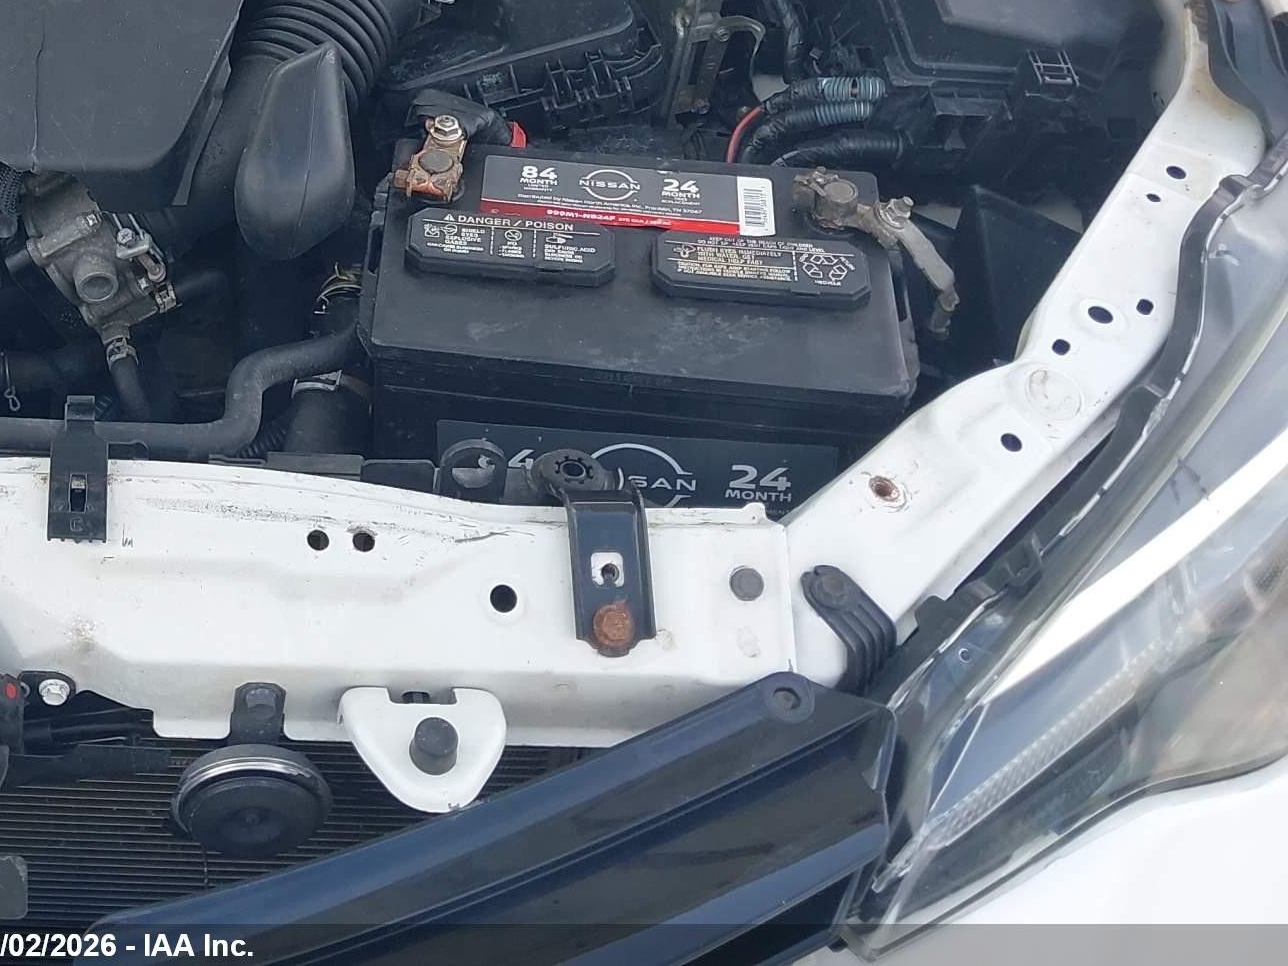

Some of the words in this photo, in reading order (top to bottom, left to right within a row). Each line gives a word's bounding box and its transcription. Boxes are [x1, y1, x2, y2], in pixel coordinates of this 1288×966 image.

[522, 166, 558, 180] 84
[520, 177, 558, 186] MONTH
[579, 179, 641, 191] NISSAN
[663, 178, 699, 193] 24
[661, 191, 701, 199] MONTH
[458, 215, 512, 227] DANGER
[525, 220, 574, 231] POISON
[729, 465, 792, 491] 24
[725, 489, 792, 502] MONTH
